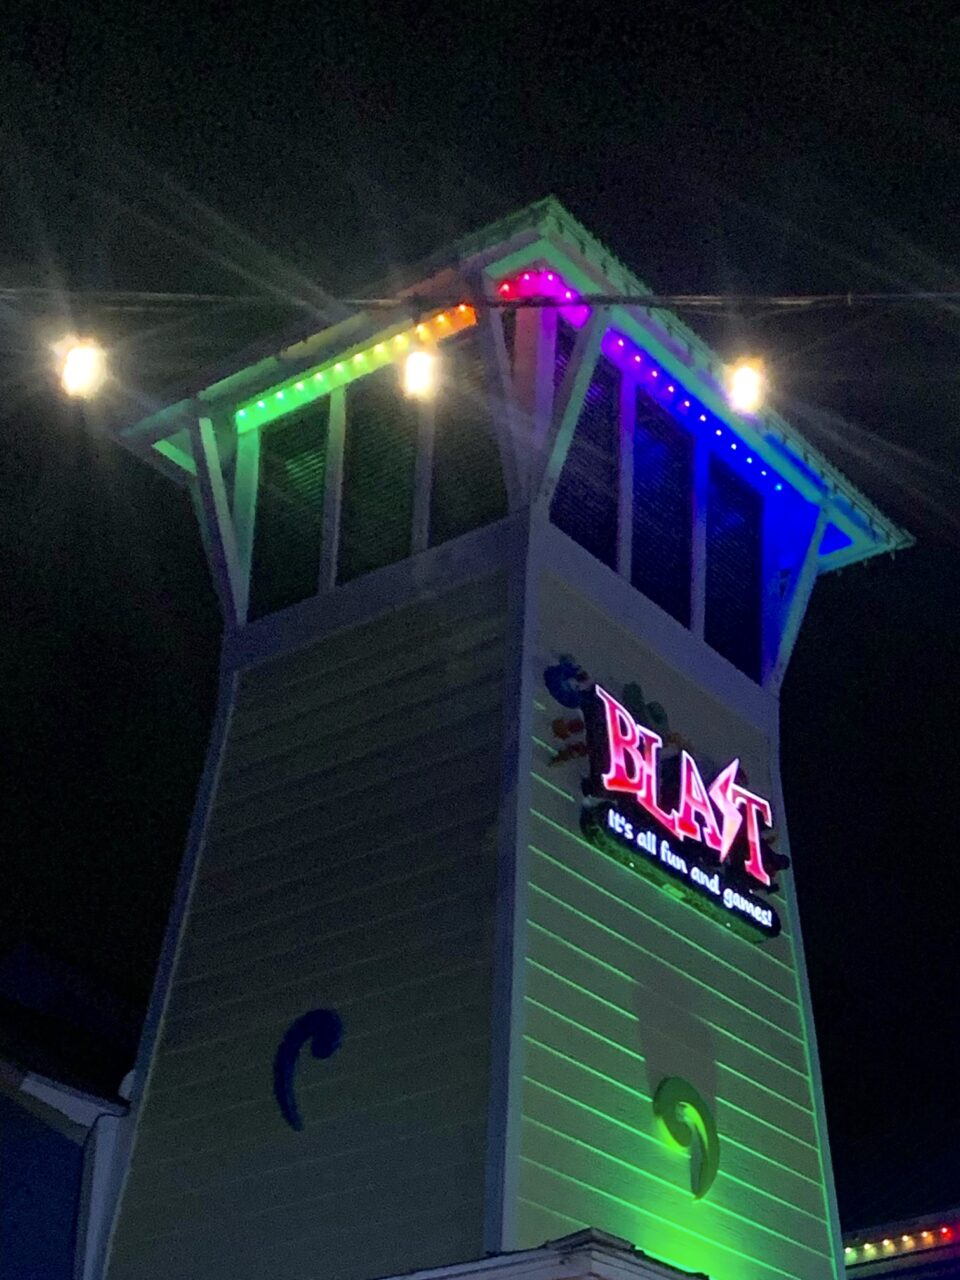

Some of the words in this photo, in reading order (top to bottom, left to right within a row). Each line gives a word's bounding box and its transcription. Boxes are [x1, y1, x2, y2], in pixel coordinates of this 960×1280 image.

[595, 684, 773, 886] BLAST
[608, 809, 634, 840] It's
[637, 830, 657, 855] all
[660, 840, 688, 874] fun
[690, 866, 720, 895] and
[722, 888, 772, 927] games!
